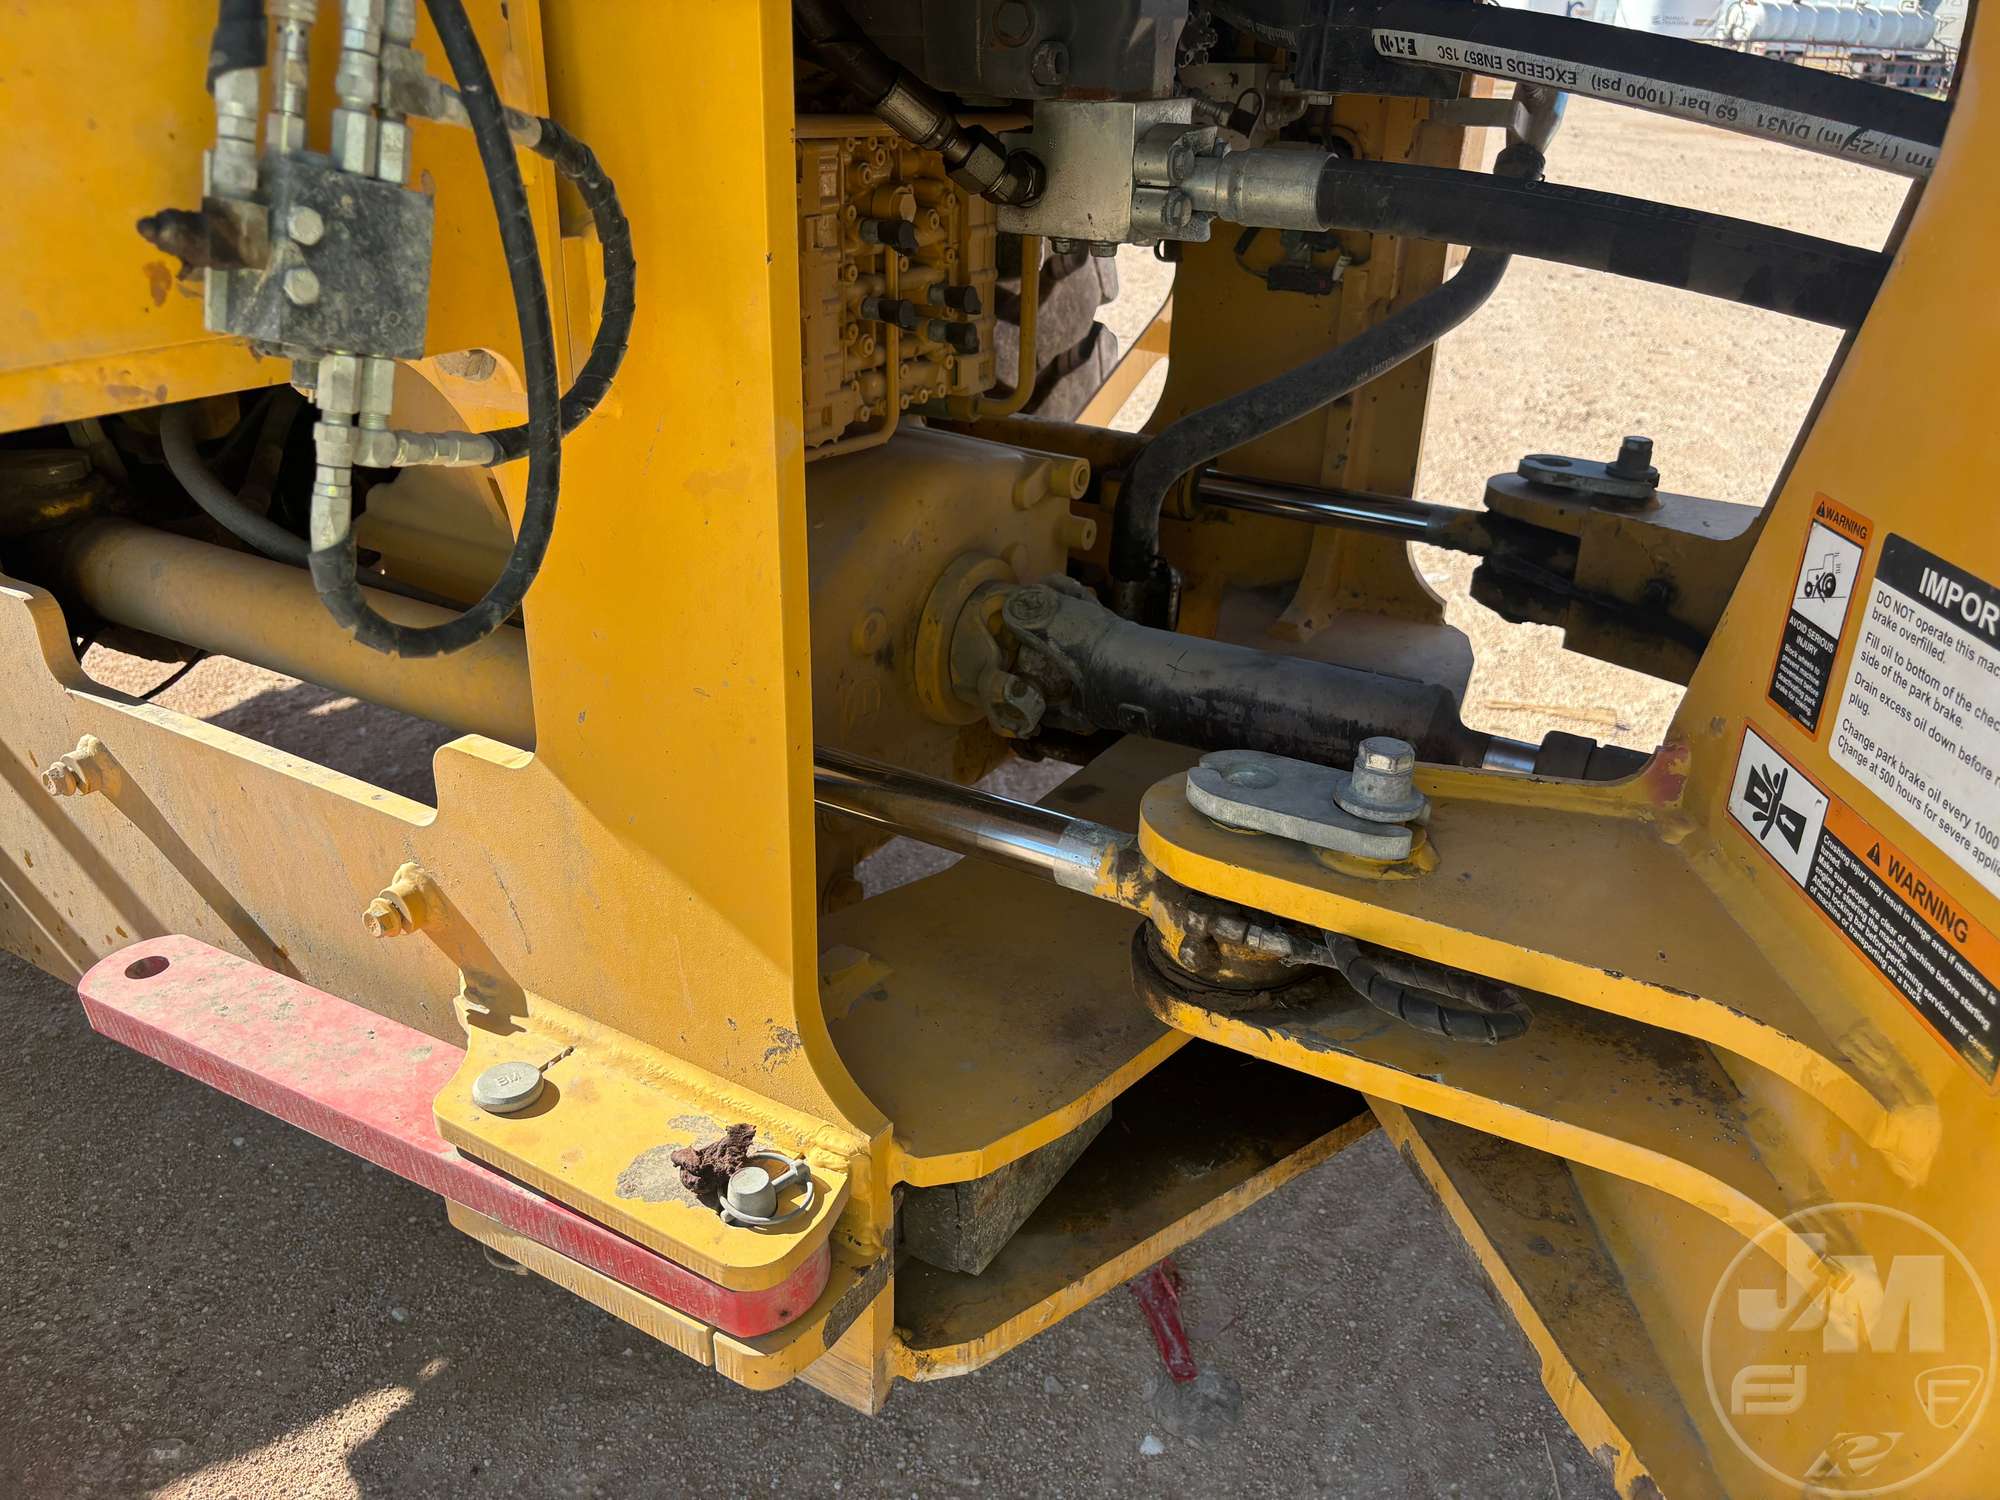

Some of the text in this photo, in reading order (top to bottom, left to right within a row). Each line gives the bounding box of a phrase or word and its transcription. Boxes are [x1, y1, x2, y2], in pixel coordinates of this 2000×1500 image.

[1437, 45, 1459, 61] 1SC
[1464, 50, 1502, 70] EN857
[1507, 57, 1577, 85] EXCEEDS
[1591, 74, 1622, 91] psi)
[1627, 83, 1674, 108] (1000
[1679, 96, 1710, 115] bar
[1716, 104, 1738, 122] 69
[1757, 114, 1810, 140] DN31
[1825, 506, 1868, 541] WARNING
[1919, 567, 2000, 637] IMPOR
[1789, 616, 1834, 654] AVOID SERIOUS
[1796, 635, 1818, 656] INJURY
[1872, 606, 1946, 664] brake overfilled.
[1876, 590, 2000, 679] DO NOT operate this mac
[1848, 692, 1870, 717] plug.
[1860, 650, 1964, 730] side of the park brake.
[1865, 631, 2000, 734] Fill oil to bottom of the chec
[1854, 671, 1879, 697] Drain
[1880, 691, 1912, 722] excess
[1914, 717, 1928, 733] oil
[1928, 726, 1956, 754] down
[1957, 745, 1993, 781] before
[1838, 734, 1869, 767] Change
[1868, 761, 1879, 775] at
[1878, 767, 1896, 788] 500
[1895, 780, 1922, 810] hours
[1922, 802, 1939, 821] for
[1937, 817, 1975, 850] severe
[1842, 718, 1876, 751] Change
[1875, 746, 1897, 770] park
[1898, 762, 1926, 791] brake
[1928, 787, 1942, 804] oil
[1942, 798, 1972, 830] every
[1974, 821, 2000, 850] 1000
[1820, 844, 1841, 870] turned.
[1815, 865, 1909, 963] engine or steering the machine.
[1823, 834, 1997, 1006] Crushing injury may result in hinge area if machine is
[1887, 855, 1970, 944] WARNING
[1810, 884, 1818, 896] of
[1816, 891, 1841, 921] machine
[1841, 918, 1850, 928] or
[1848, 924, 1888, 970] transporting
[1887, 964, 1898, 978] on
[1902, 979, 1923, 1006] truck.
[1811, 874, 1832, 899] Attach
[1831, 893, 1854, 921] locking
[1853, 914, 1866, 931] bar
[1864, 926, 1887, 953] before
[1885, 950, 1924, 994] performing
[1923, 988, 1951, 1019] service
[1949, 1015, 1970, 1037] near
[1817, 853, 1992, 1032] Make sure people are clear of machine before starting
